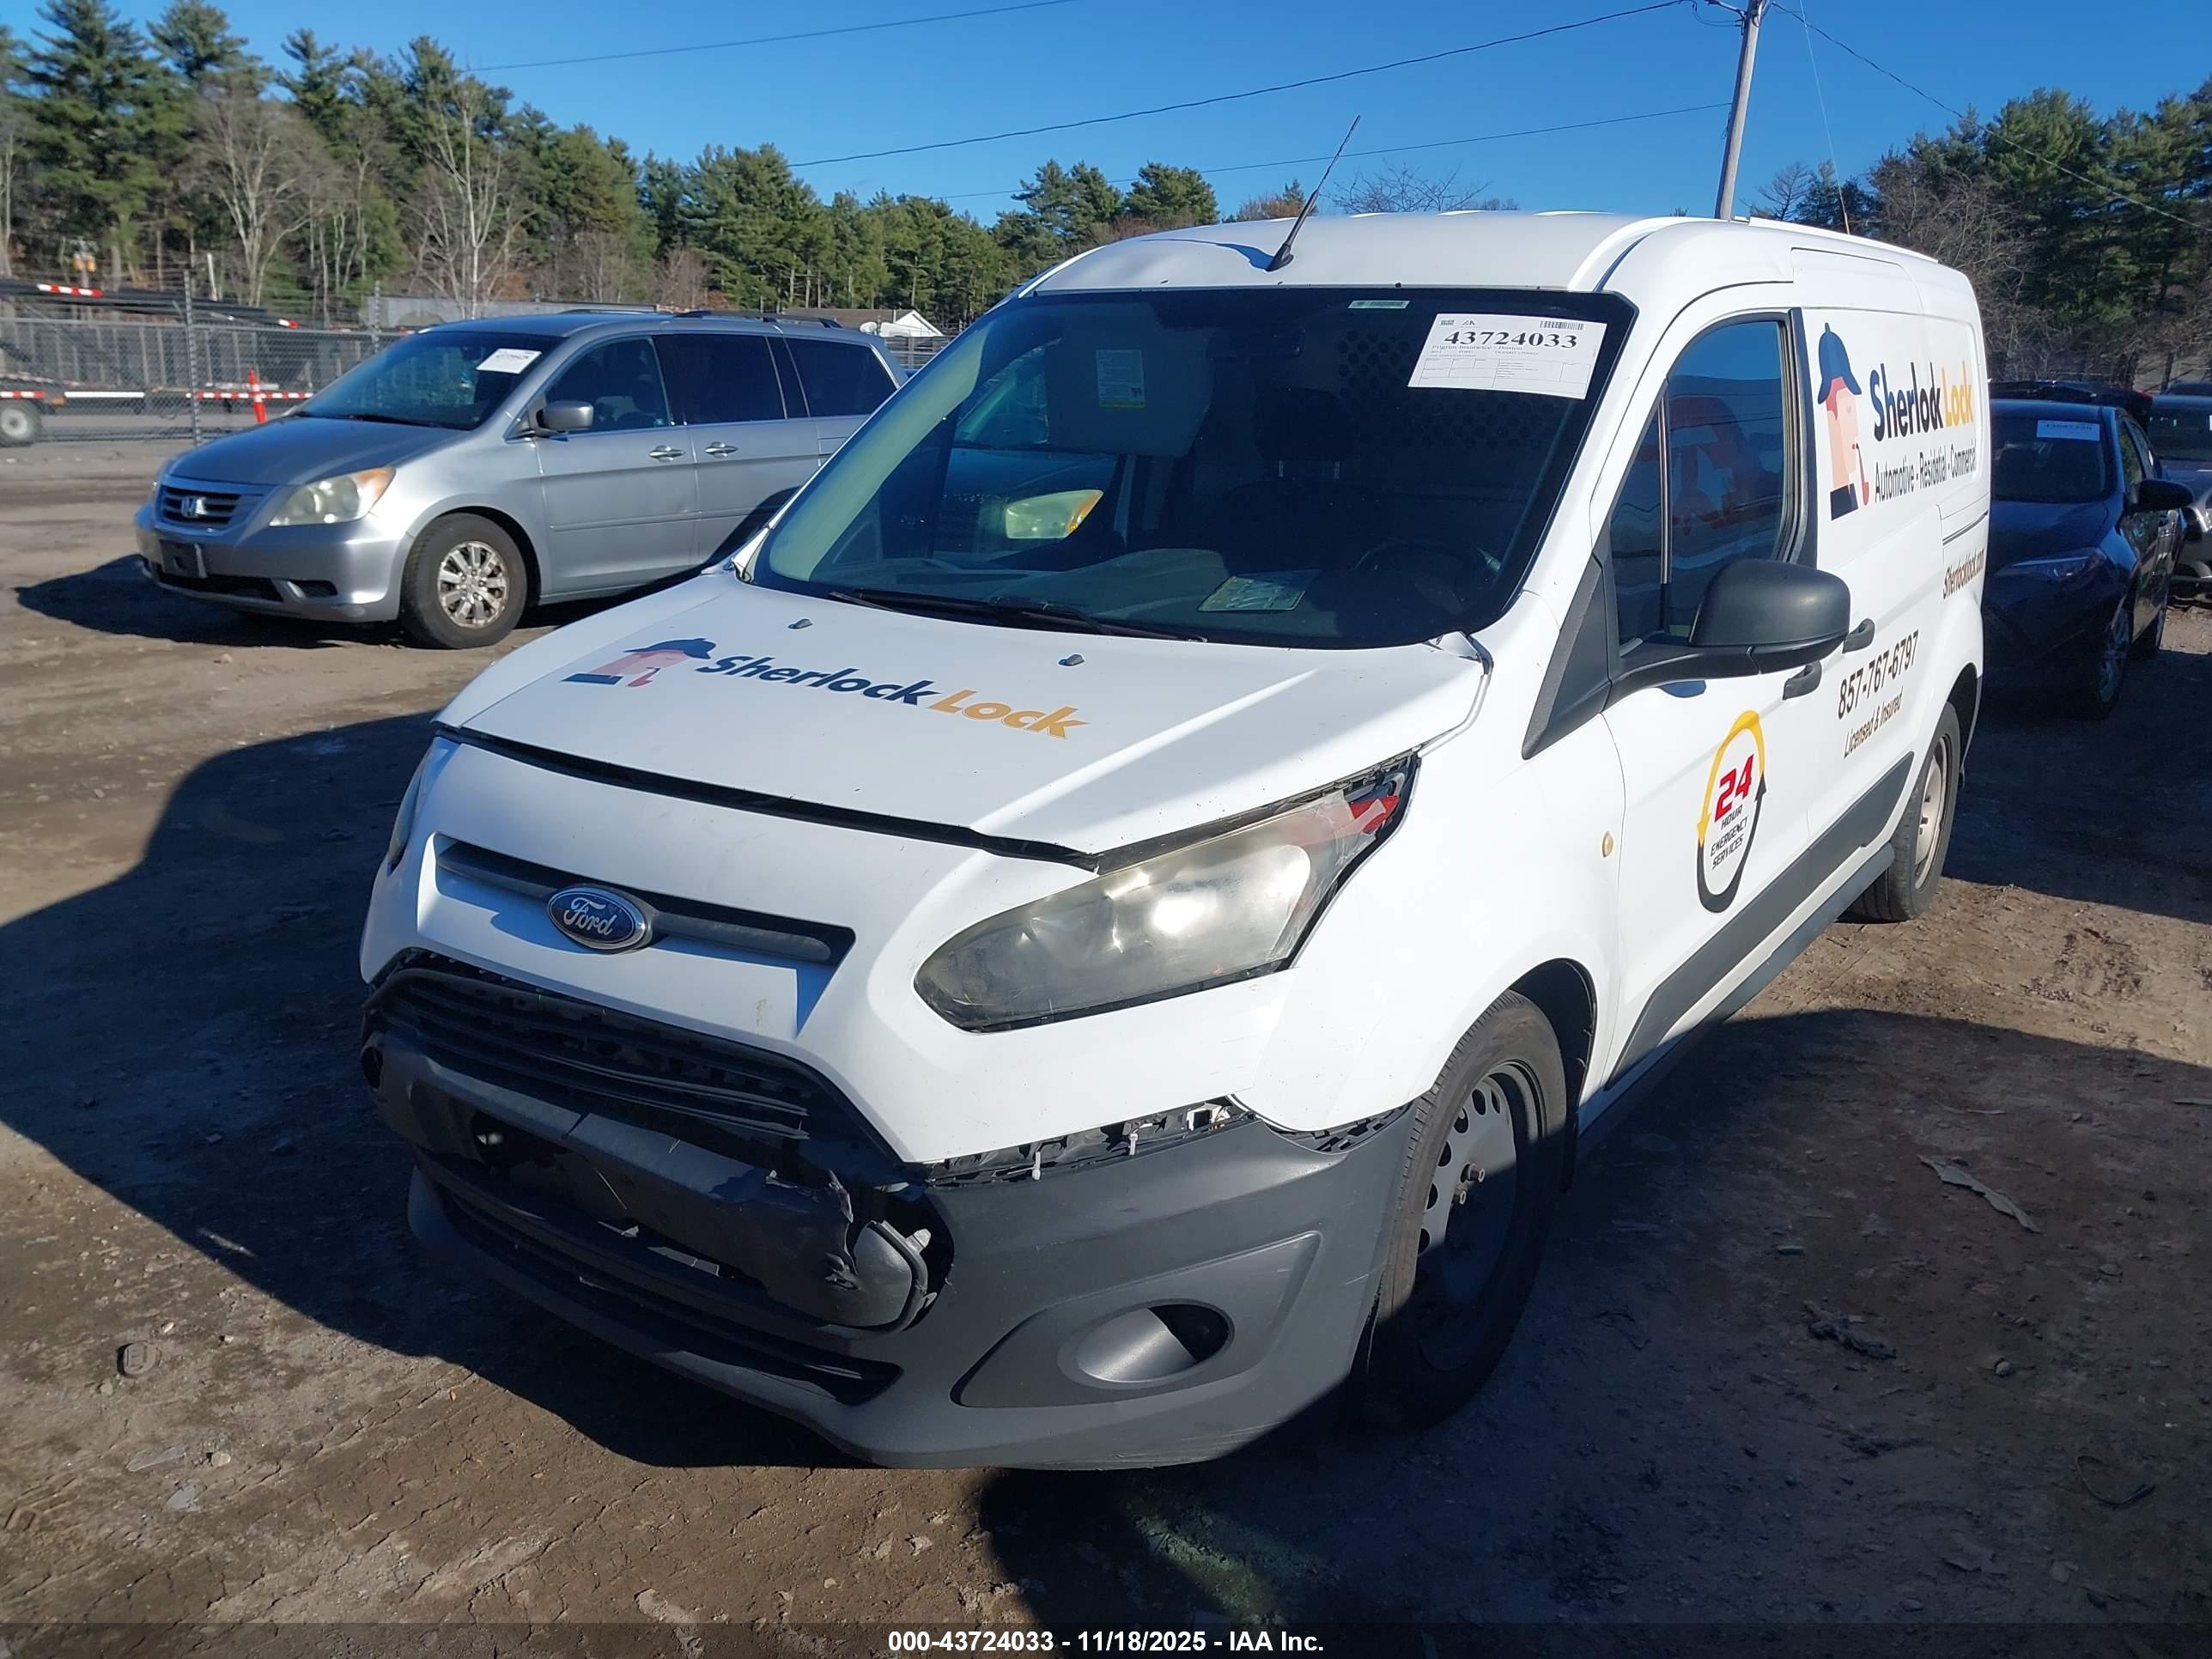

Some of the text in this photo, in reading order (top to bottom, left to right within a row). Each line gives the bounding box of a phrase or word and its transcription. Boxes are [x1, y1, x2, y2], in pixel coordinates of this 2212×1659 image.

[1443, 331, 1577, 349] 43724033
[1875, 455, 1915, 503] Automotive
[1838, 629, 1919, 720] 857-767-6797
[1844, 708, 1875, 759] Licensed
[1879, 684, 1904, 727] Insured
[1714, 753, 1753, 822] 24
[1711, 814, 1748, 857] EMERGENCY
[1721, 804, 1743, 831] HOUR
[1711, 833, 1744, 870] SERVICES
[563, 896, 618, 936] Ford
